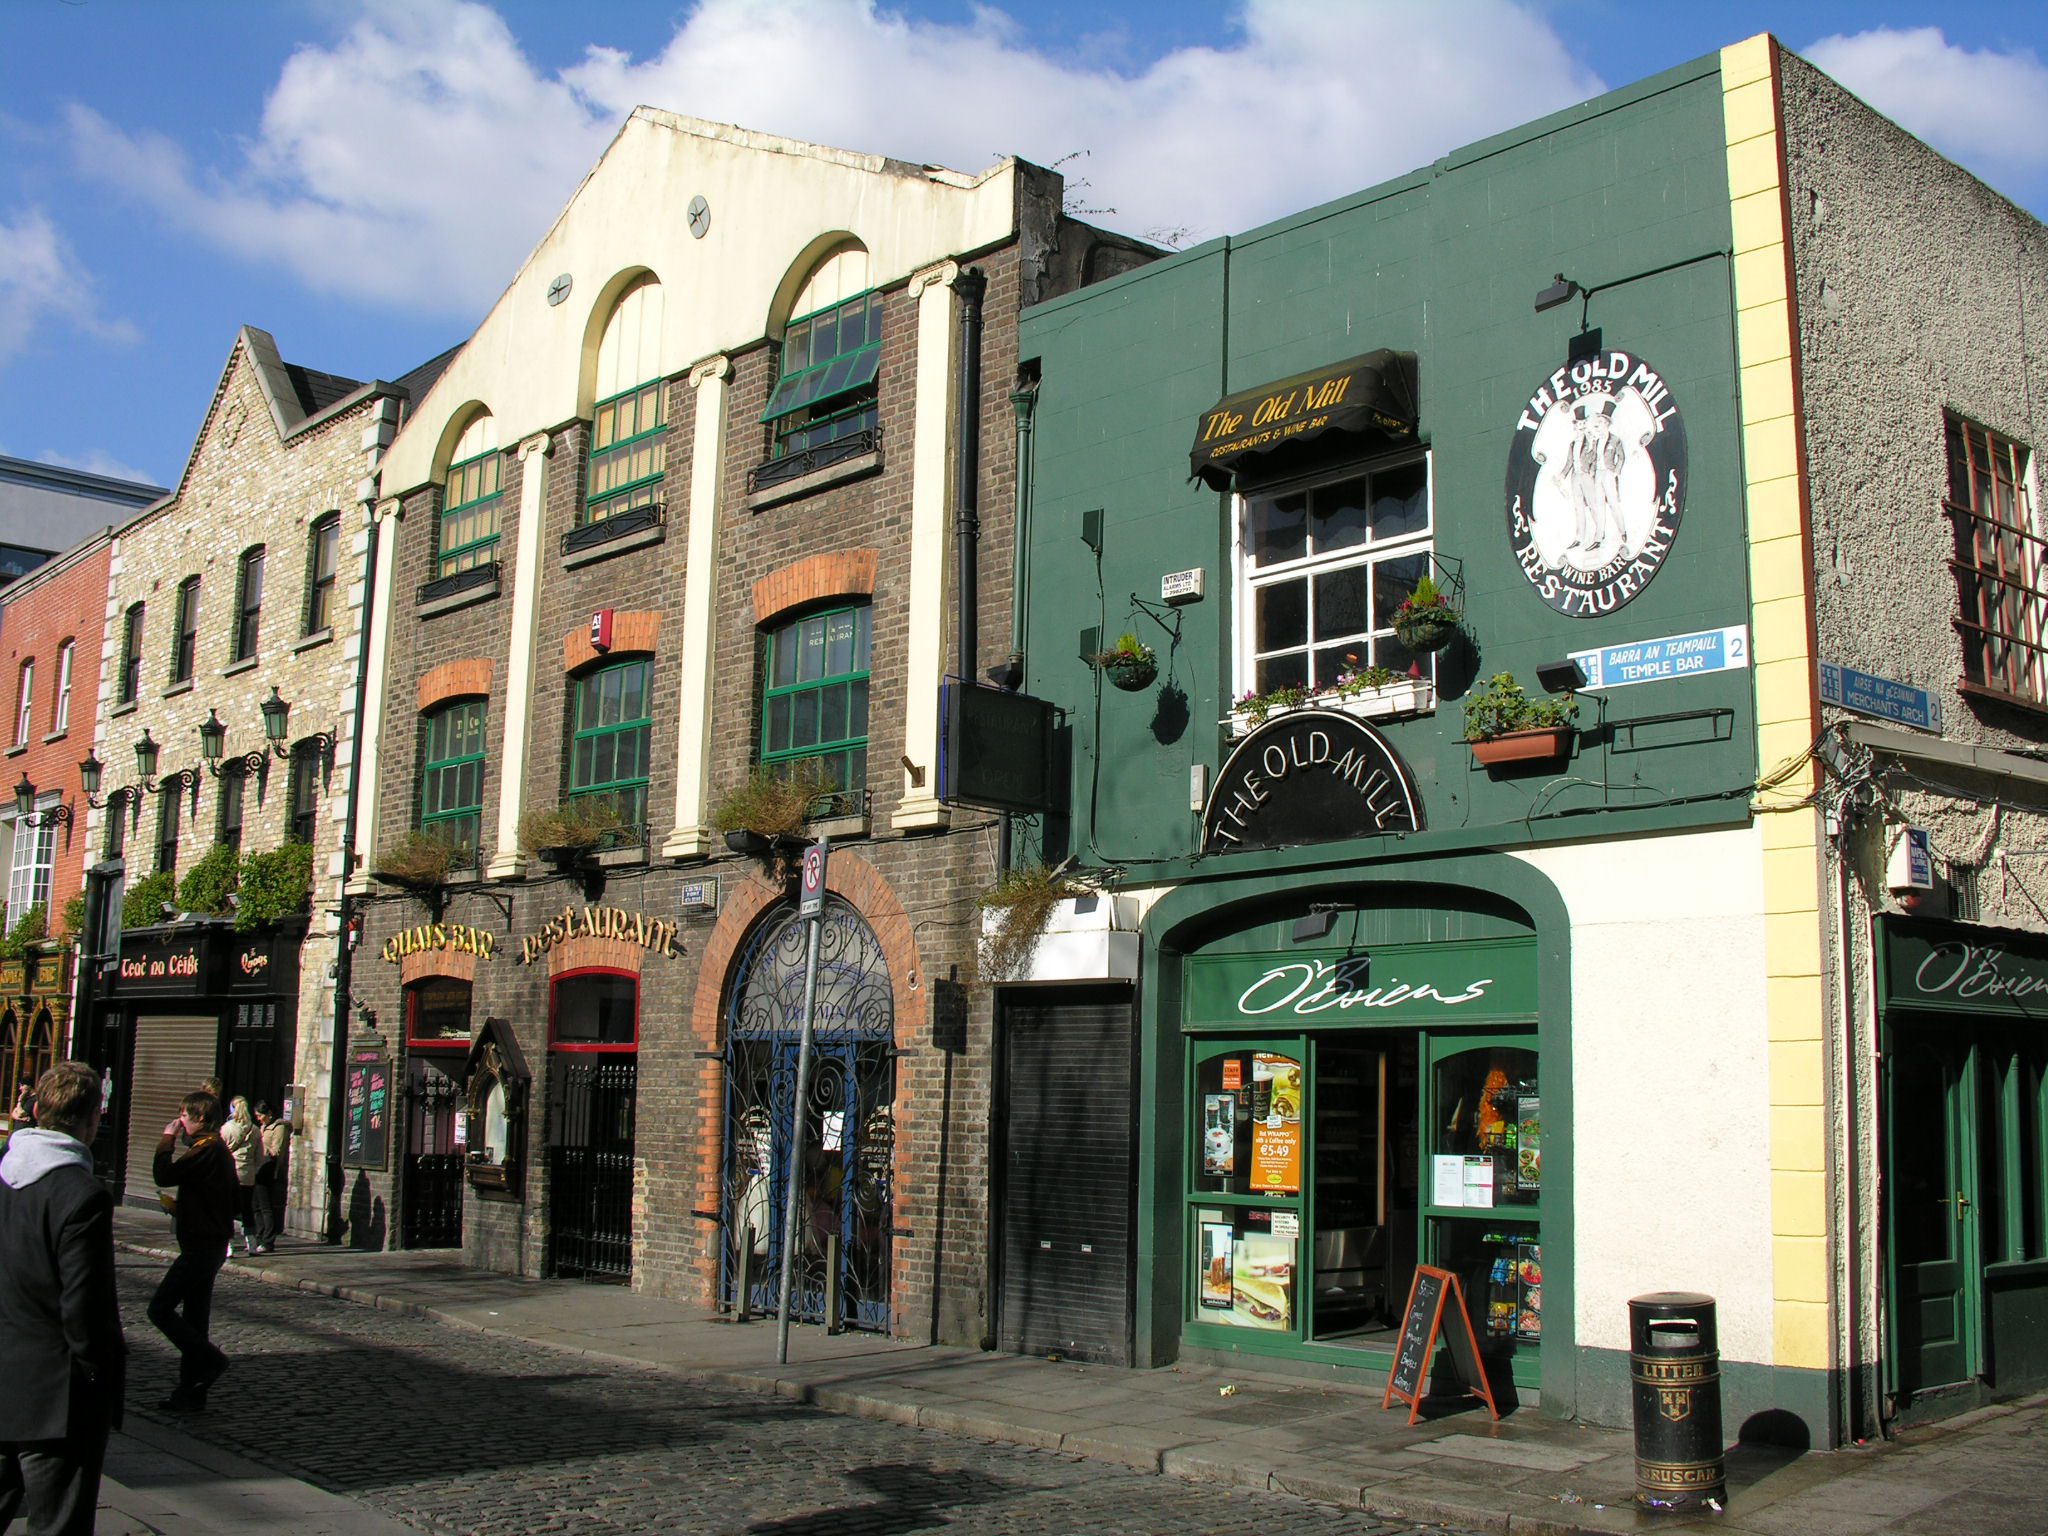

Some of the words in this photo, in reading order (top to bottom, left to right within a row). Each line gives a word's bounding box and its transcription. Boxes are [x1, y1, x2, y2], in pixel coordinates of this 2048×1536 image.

[1516, 367, 1572, 431] THE
[1571, 352, 1630, 383] OLD
[1626, 363, 1677, 433] MILL
[1573, 379, 1613, 399] 1985
[1202, 411, 1244, 441] The
[1252, 391, 1297, 427] Old
[1294, 375, 1352, 415] Mill
[1209, 431, 1270, 459] RESTAURANTS
[1273, 429, 1281, 440] &
[1283, 421, 1308, 437] WINE
[1308, 415, 1329, 430] BAR
[1163, 572, 1193, 584] INTRUDER
[1516, 517, 1674, 614] RESTAURANT
[1561, 563, 1596, 585] WINE
[1599, 555, 1627, 582] BAR
[1609, 649, 1641, 666] BARRA
[1644, 645, 1660, 659] AN
[1665, 636, 1718, 657] TEAMPAILL
[1730, 638, 1743, 658] 2
[1621, 660, 1671, 680] TEMPLE
[1676, 655, 1703, 672] BAR
[1902, 707, 1924, 723] ARCH
[1930, 703, 1938, 721] 2
[1214, 770, 1269, 841] THE
[1264, 732, 1330, 778] OLD
[383, 923, 446, 965] QUAYS
[452, 924, 496, 961] BAR
[151, 960, 165, 976] na
[1238, 957, 1493, 1015] O'Briens
[1643, 1363, 1705, 1378] LITTER
[1640, 1466, 1717, 1482] BRUSCAR
